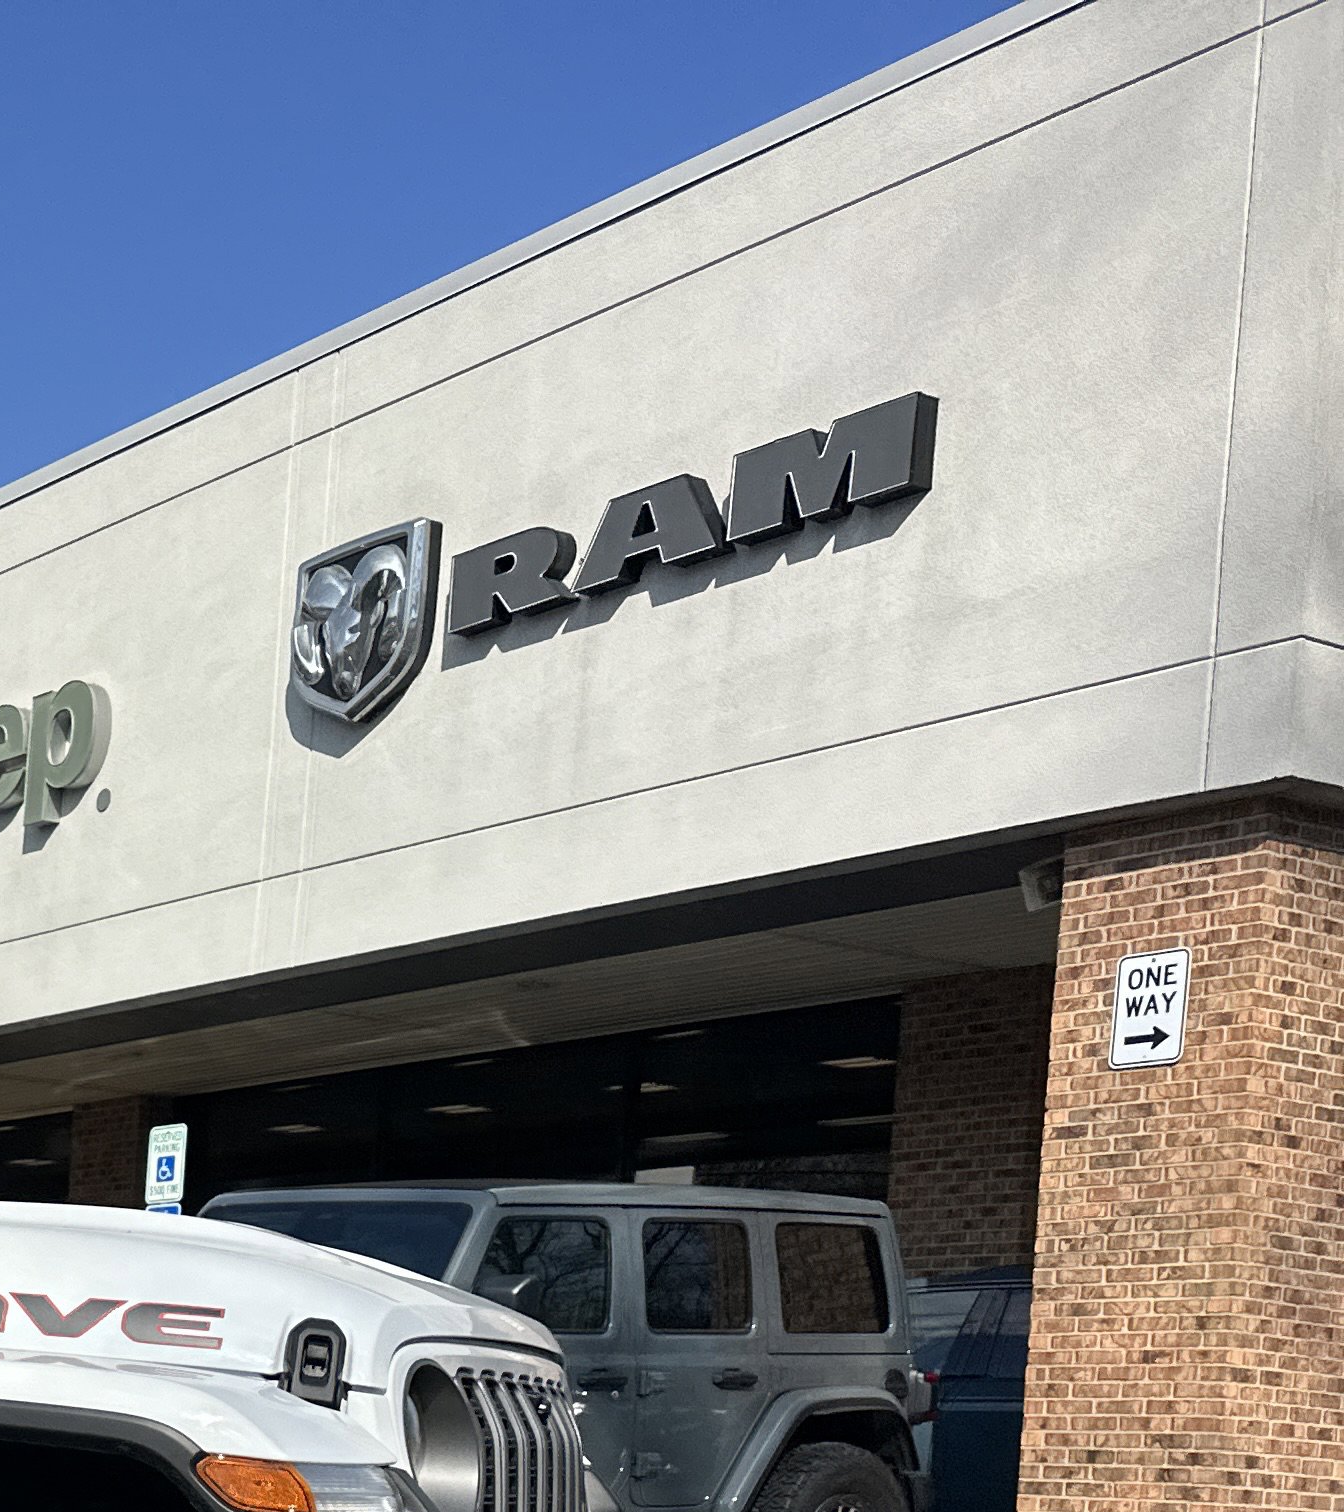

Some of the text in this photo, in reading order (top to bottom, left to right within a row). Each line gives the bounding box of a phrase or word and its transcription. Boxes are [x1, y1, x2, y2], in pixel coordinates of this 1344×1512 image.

[448, 392, 939, 636] RAM
[1127, 963, 1179, 990] ONE
[1125, 990, 1178, 1018] WAY
